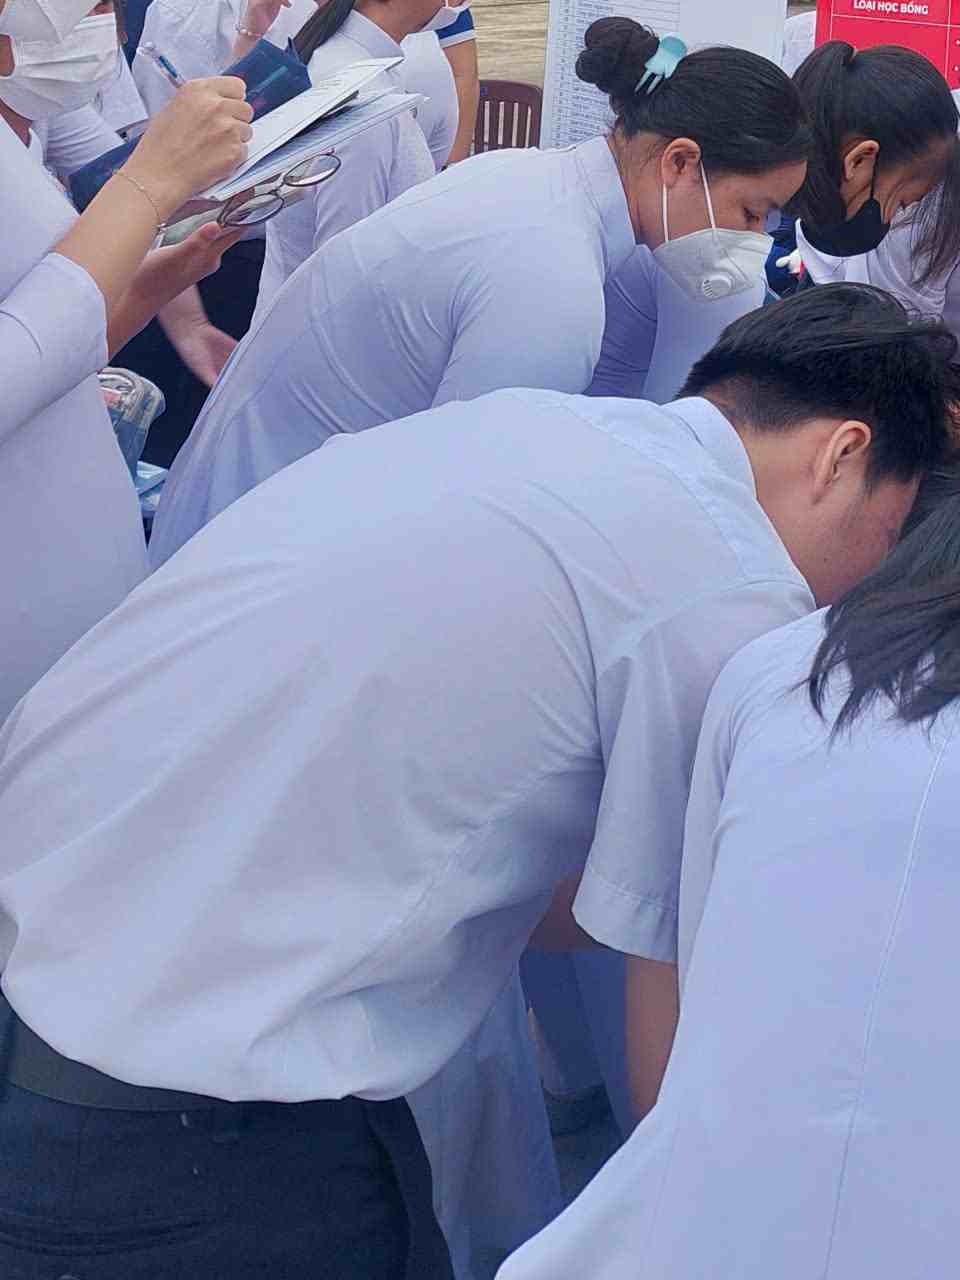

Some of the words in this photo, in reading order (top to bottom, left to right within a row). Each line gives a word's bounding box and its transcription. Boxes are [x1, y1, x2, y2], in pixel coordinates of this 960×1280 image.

[853, 0, 877, 16] LOẠI
[878, 1, 898, 17] HỌC
[899, 0, 928, 16] BỔNG
